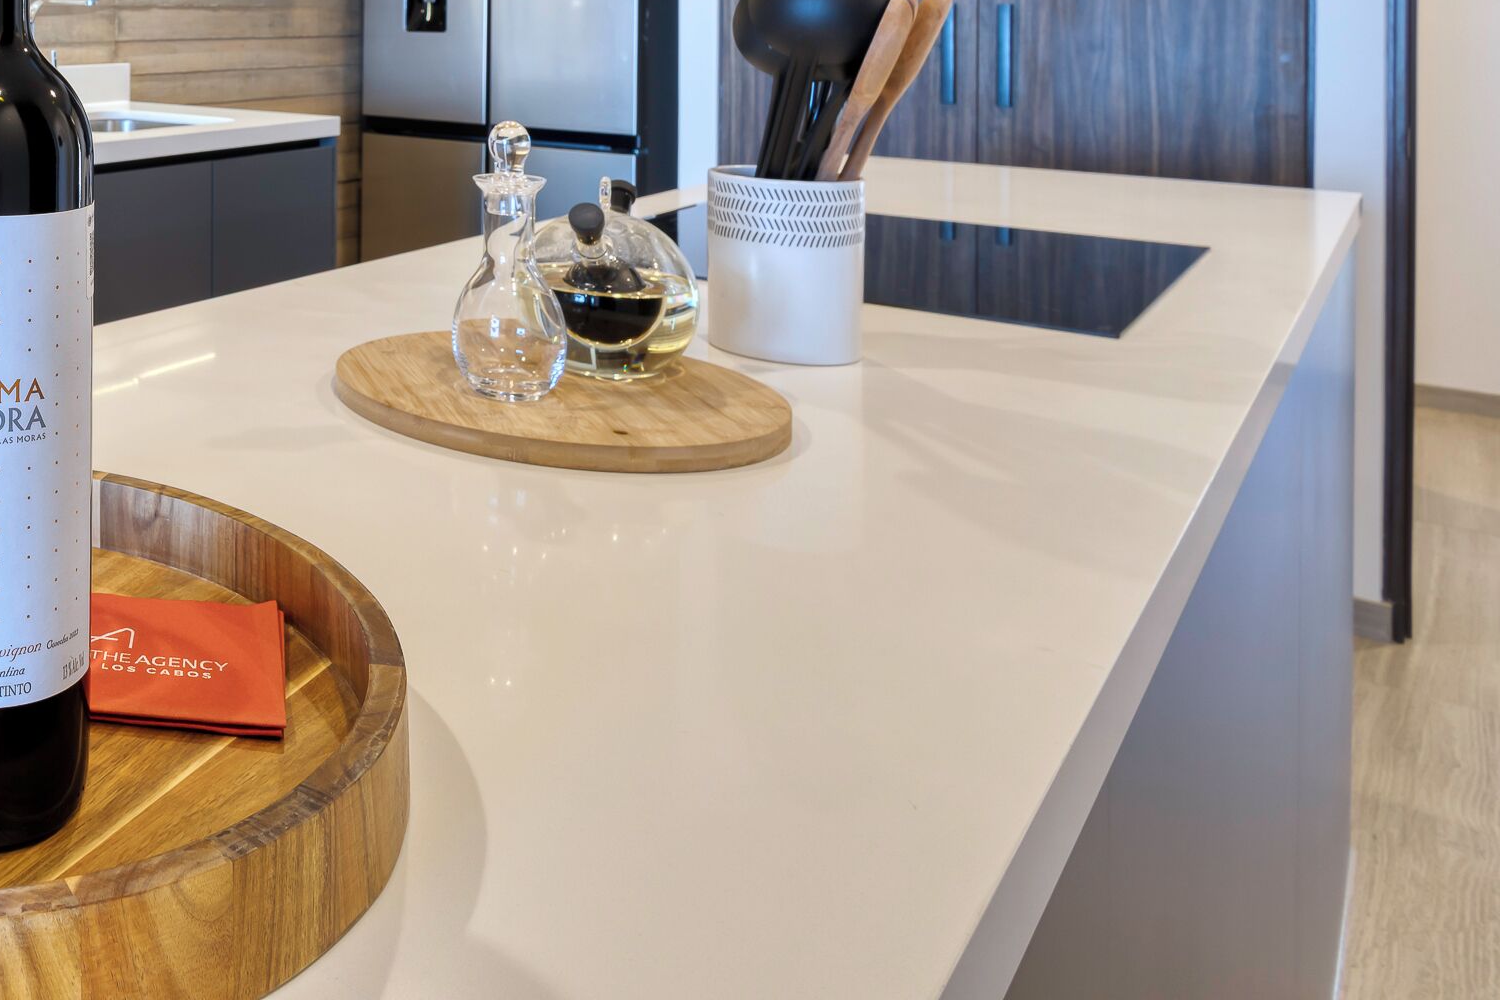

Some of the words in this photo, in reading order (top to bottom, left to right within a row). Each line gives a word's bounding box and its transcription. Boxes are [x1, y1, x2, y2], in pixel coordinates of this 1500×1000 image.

[16, 432, 46, 444] MORAS
[91, 649, 132, 664] THE
[135, 655, 229, 672] AGENCY
[101, 663, 136, 673] LOS
[146, 667, 212, 680] CABOS
